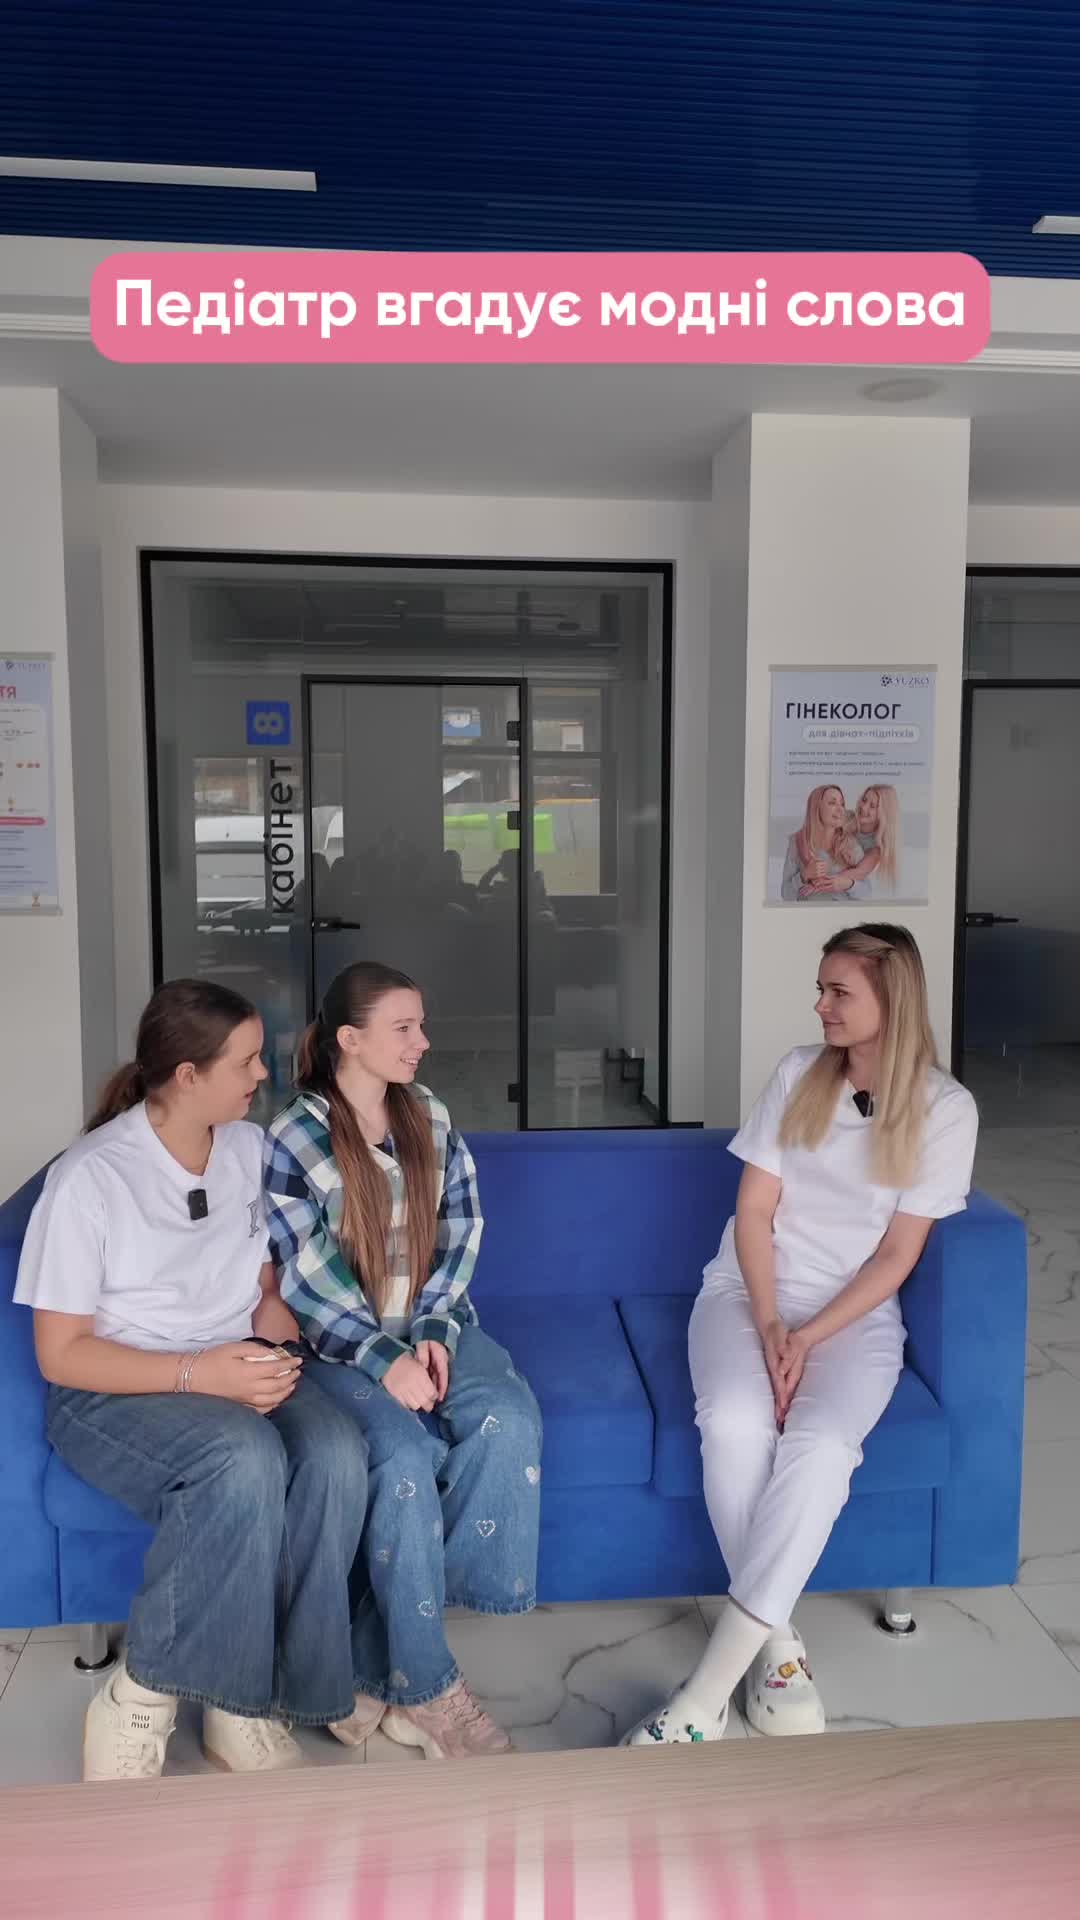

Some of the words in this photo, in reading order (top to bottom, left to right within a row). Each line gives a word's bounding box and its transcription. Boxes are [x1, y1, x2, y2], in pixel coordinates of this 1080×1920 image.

[785, 702, 901, 719] ГІНЕКОЛОГ
[253, 711, 285, 737] 8
[808, 728, 828, 738] для
[263, 759, 295, 913] кабінет
